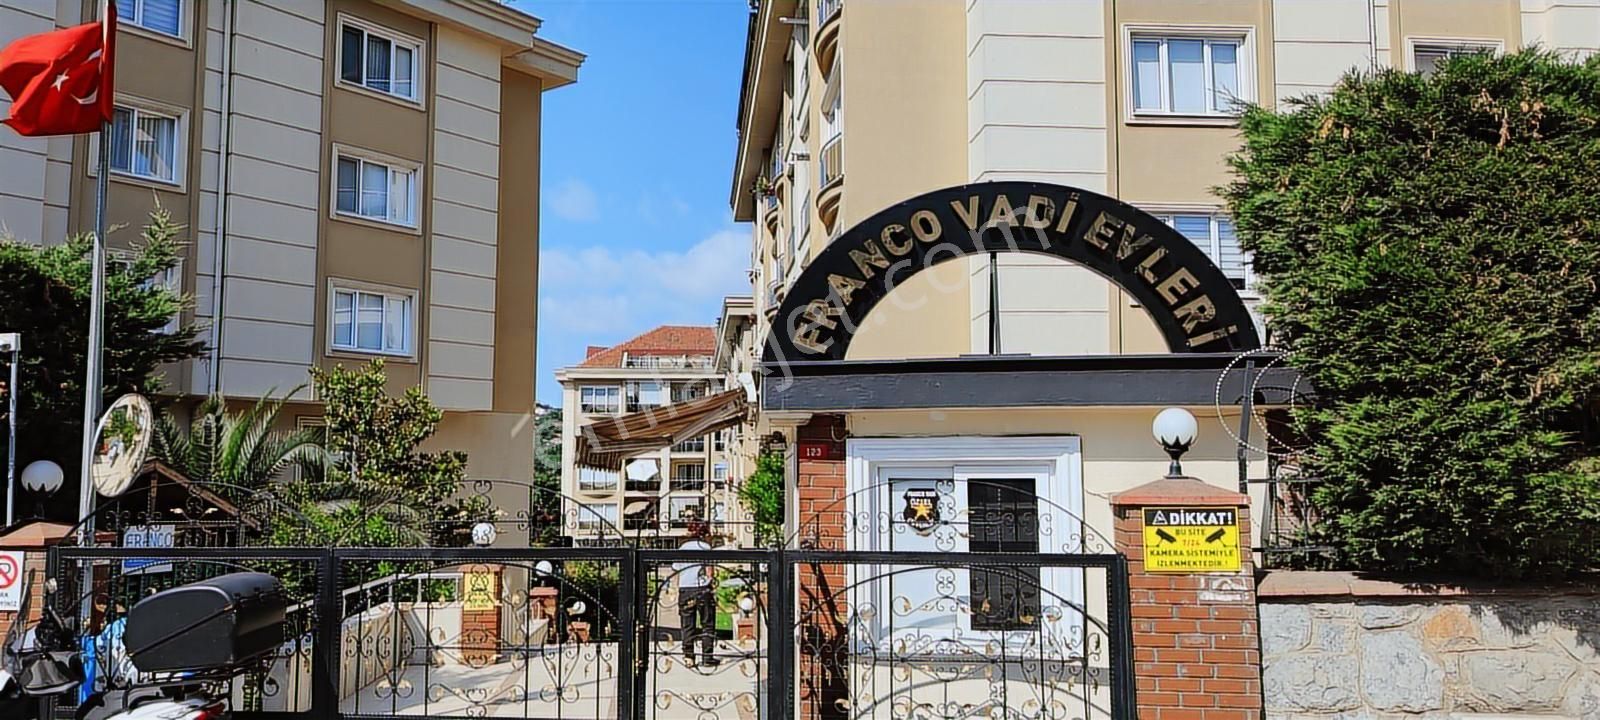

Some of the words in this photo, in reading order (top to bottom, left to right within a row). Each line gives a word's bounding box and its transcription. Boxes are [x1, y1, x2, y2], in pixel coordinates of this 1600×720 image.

[792, 209, 944, 355] FRANCO
[950, 191, 1081, 235] VADİ
[1083, 209, 1240, 350] EVLERİ
[806, 446, 822, 457] 123
[1169, 508, 1233, 525] DİKKAT!
[1175, 528, 1186, 536] BU
[1150, 549, 1185, 557] KAMERA
